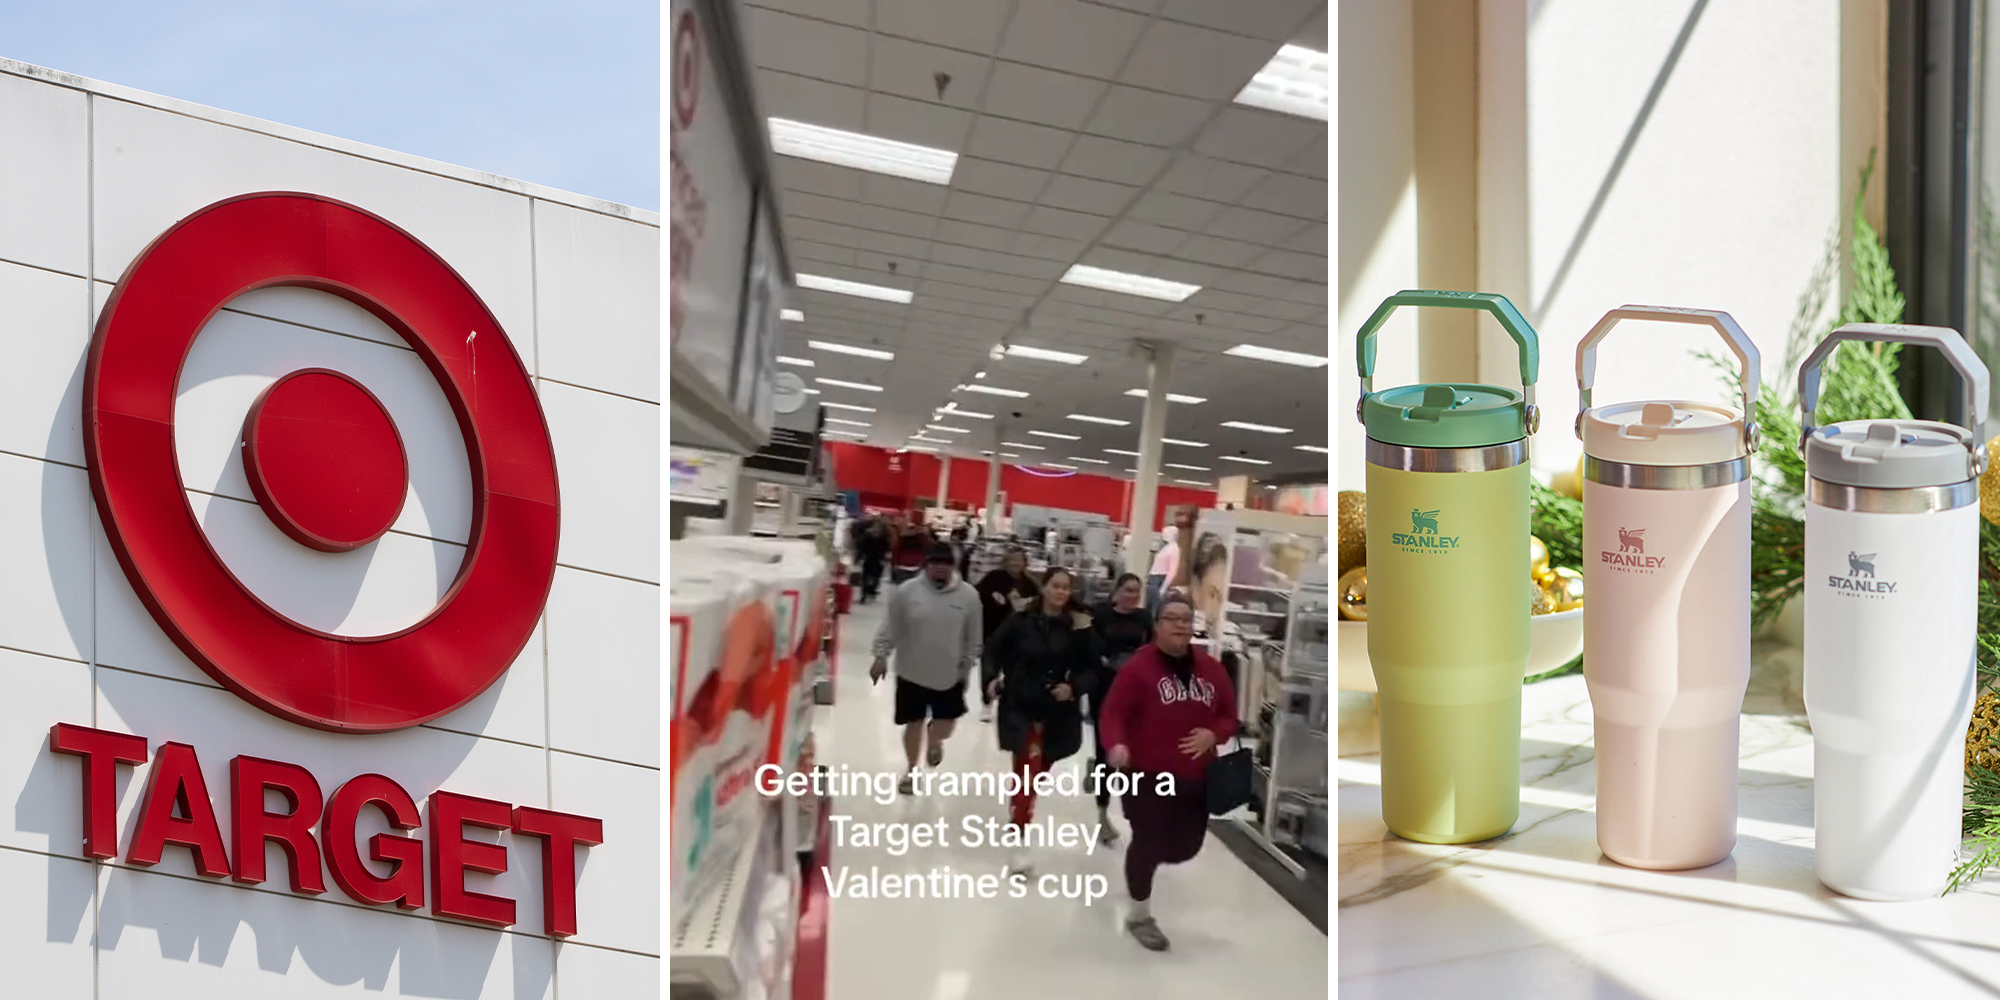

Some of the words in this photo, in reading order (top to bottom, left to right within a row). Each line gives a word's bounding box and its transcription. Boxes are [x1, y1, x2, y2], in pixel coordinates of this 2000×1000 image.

[1392, 532, 1460, 548] STANLEY
[1601, 551, 1666, 569] STANLEY
[1609, 565, 1630, 573] SINCE
[1828, 575, 1897, 593] STANLEY
[50, 722, 603, 938] TARGET
